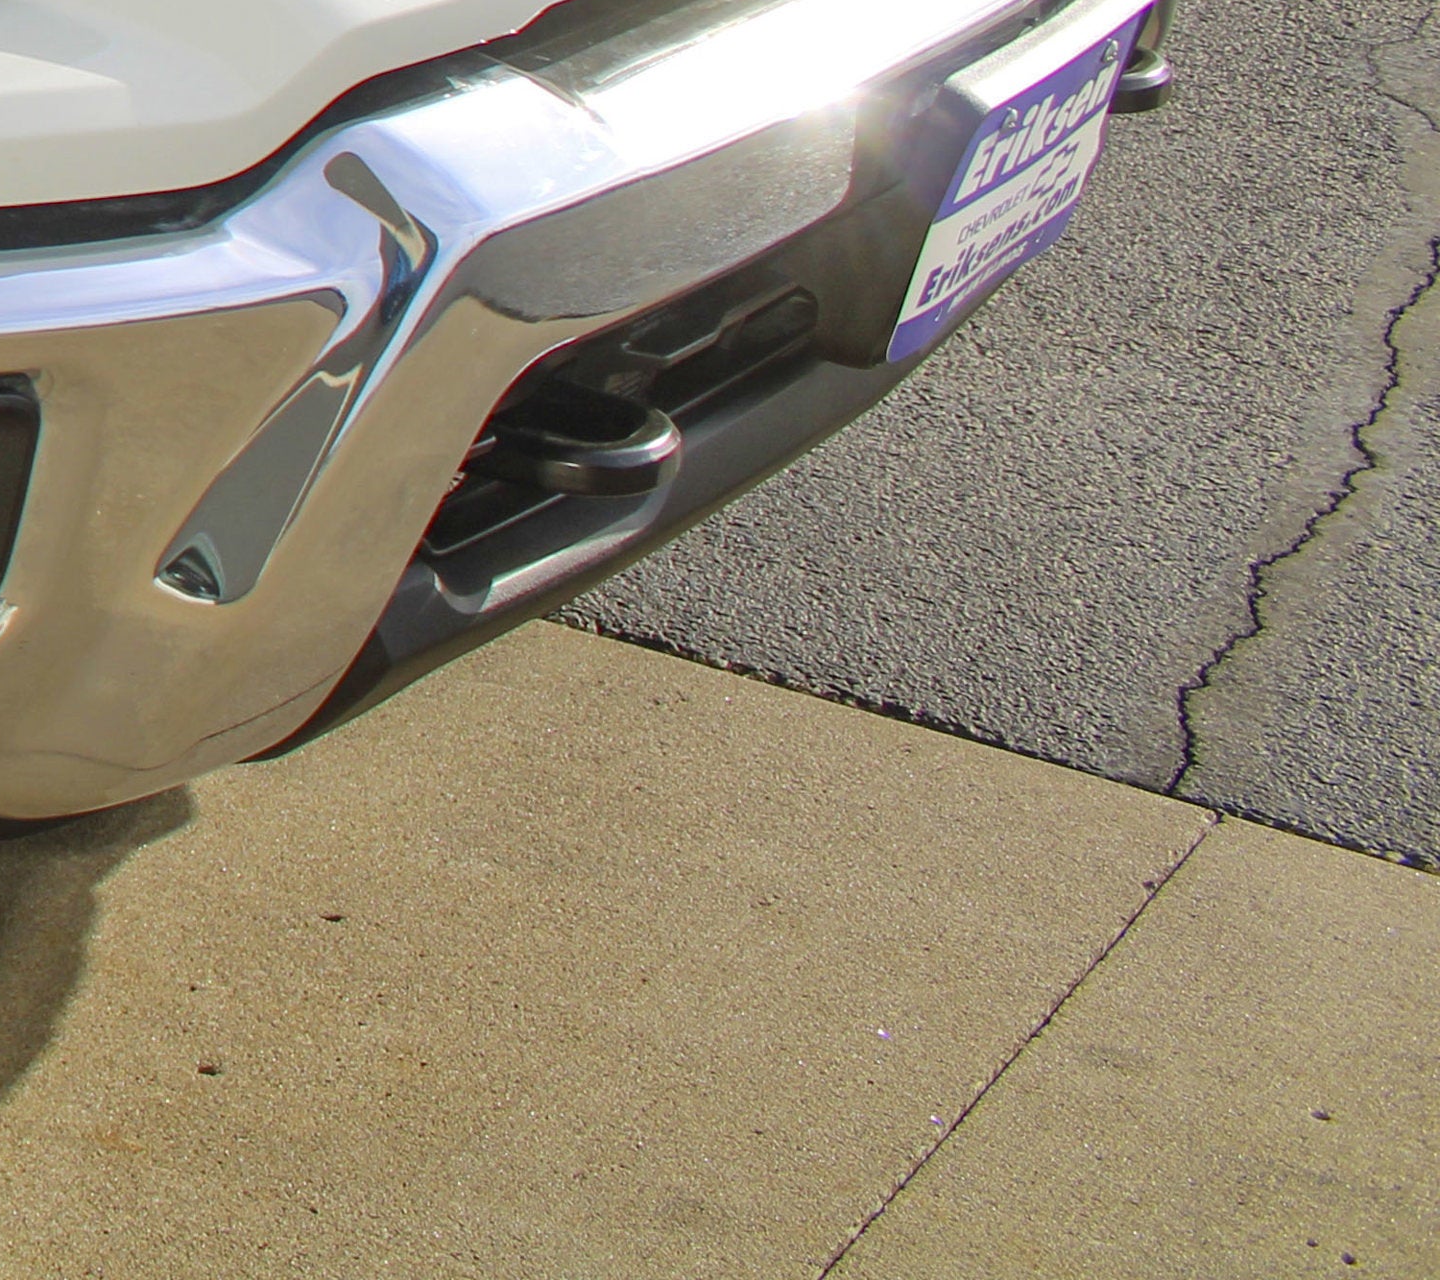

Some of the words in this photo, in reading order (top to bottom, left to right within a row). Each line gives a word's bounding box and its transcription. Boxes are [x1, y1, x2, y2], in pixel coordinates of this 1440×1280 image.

[954, 60, 1120, 204] Eriksen
[916, 171, 1081, 309] Eriksens.com
[957, 183, 1032, 245] CHEVROLET
